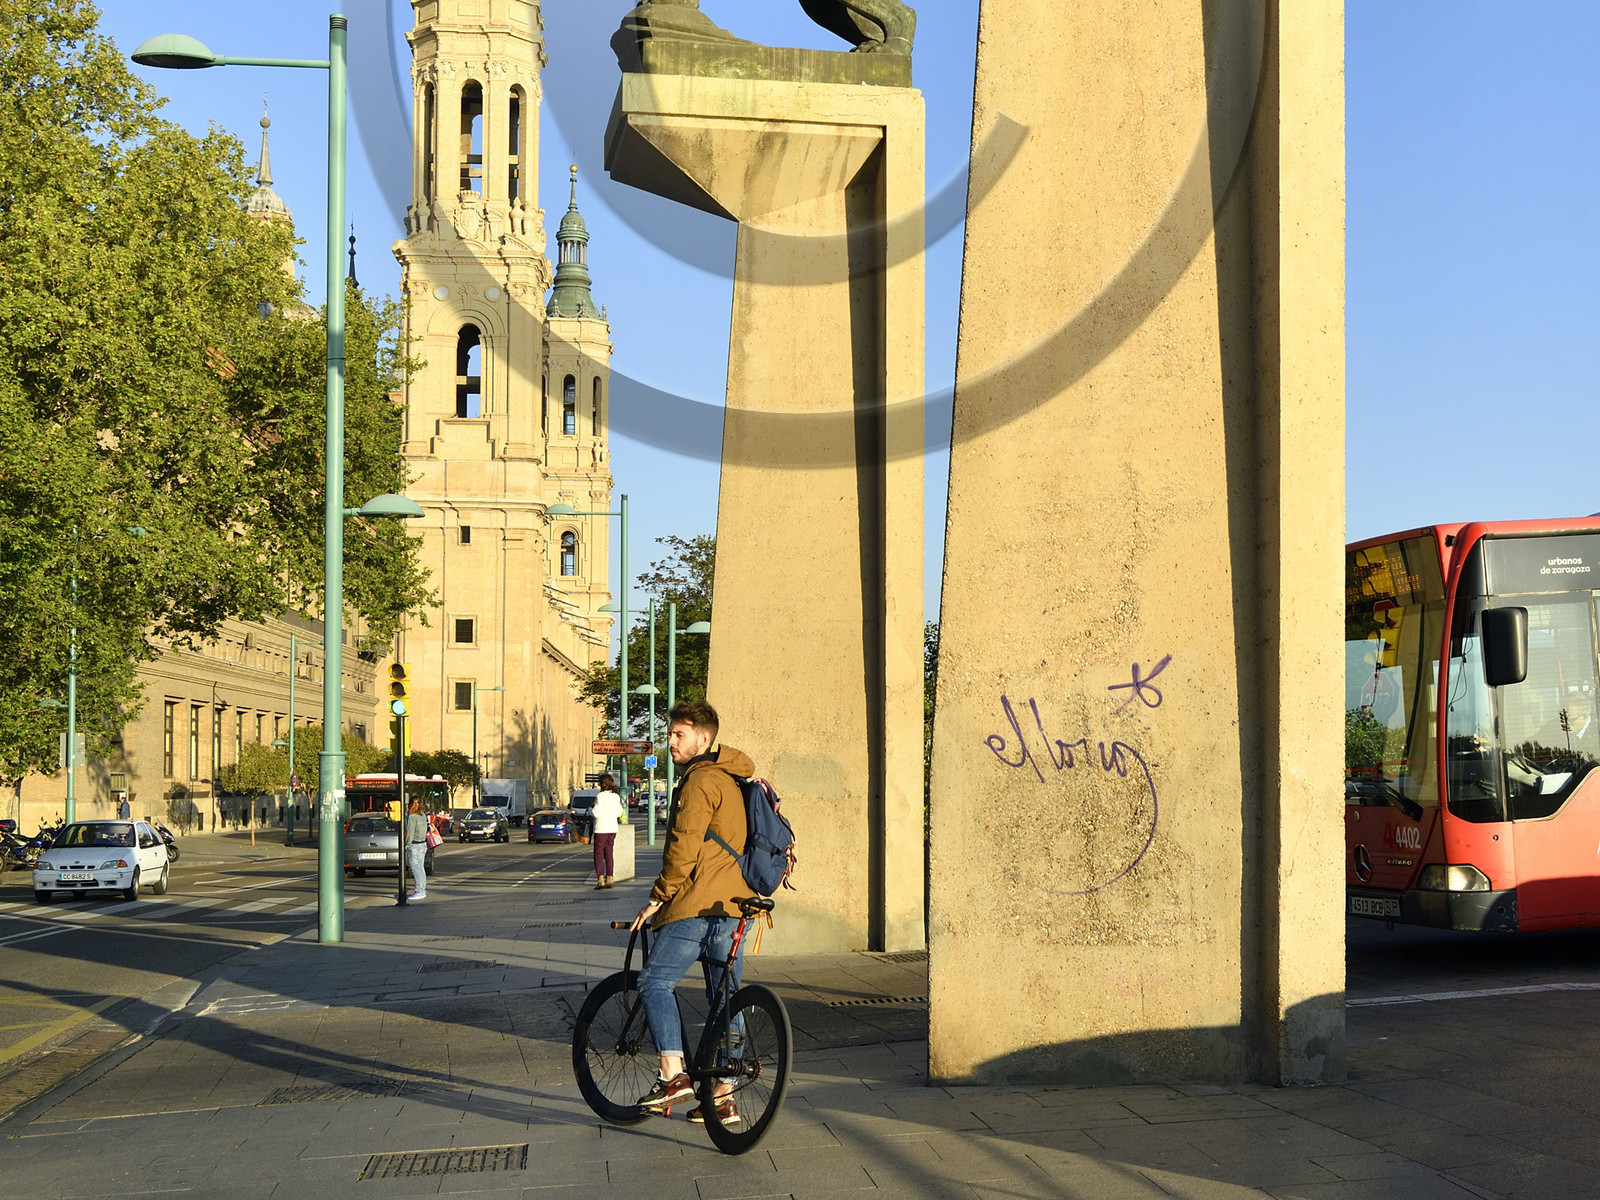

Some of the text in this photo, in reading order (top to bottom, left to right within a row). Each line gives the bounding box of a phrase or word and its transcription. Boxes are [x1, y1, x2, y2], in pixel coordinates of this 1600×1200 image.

[1547, 557, 1583, 566] urbanos
[1540, 566, 1591, 575] de zaragoza
[1395, 825, 1421, 849] 4402
[1353, 898, 1369, 912] 4513
[1385, 900, 1398, 914] SP
